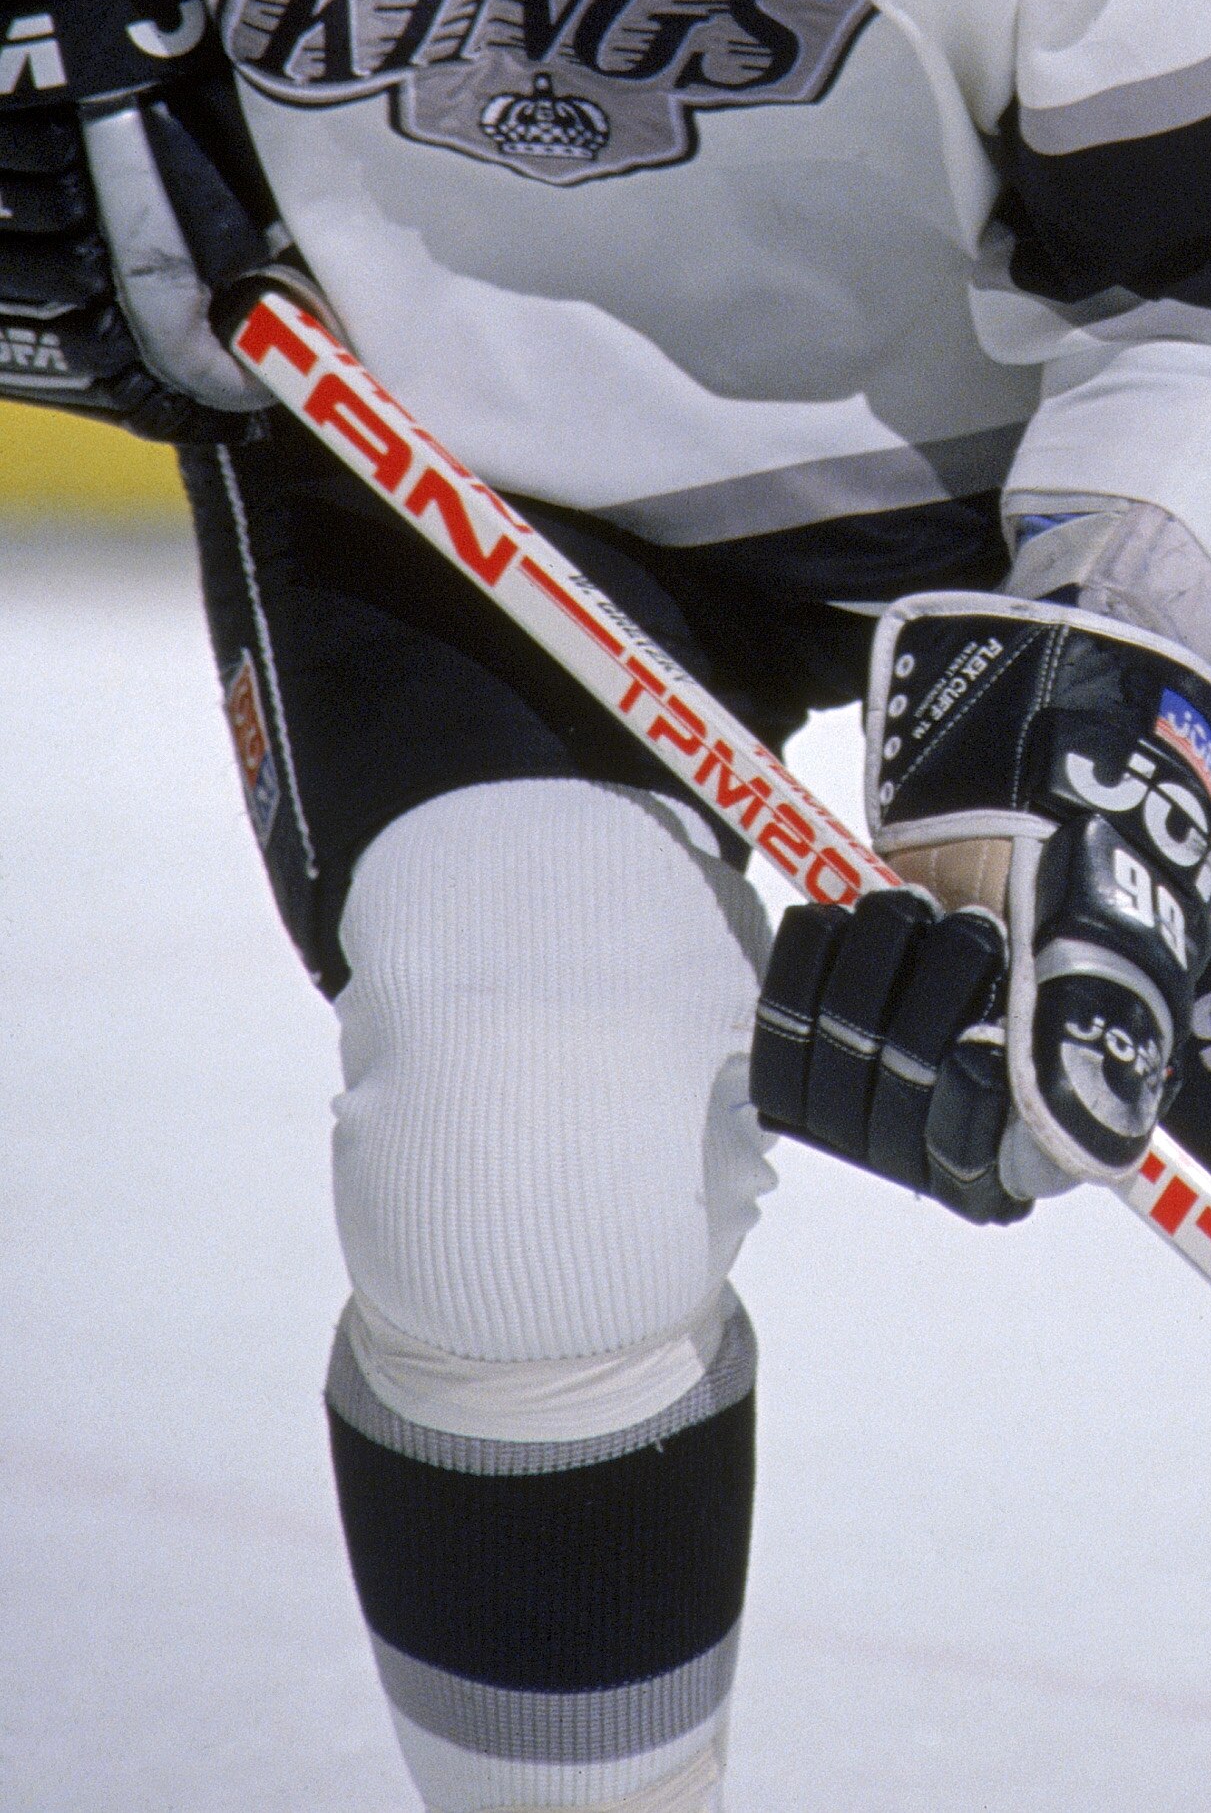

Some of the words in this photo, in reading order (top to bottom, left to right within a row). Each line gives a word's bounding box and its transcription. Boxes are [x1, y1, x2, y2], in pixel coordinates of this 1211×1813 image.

[960, 637, 1004, 682] FLEX
[931, 676, 968, 721] CUFF
[1113, 848, 1188, 971] 99
